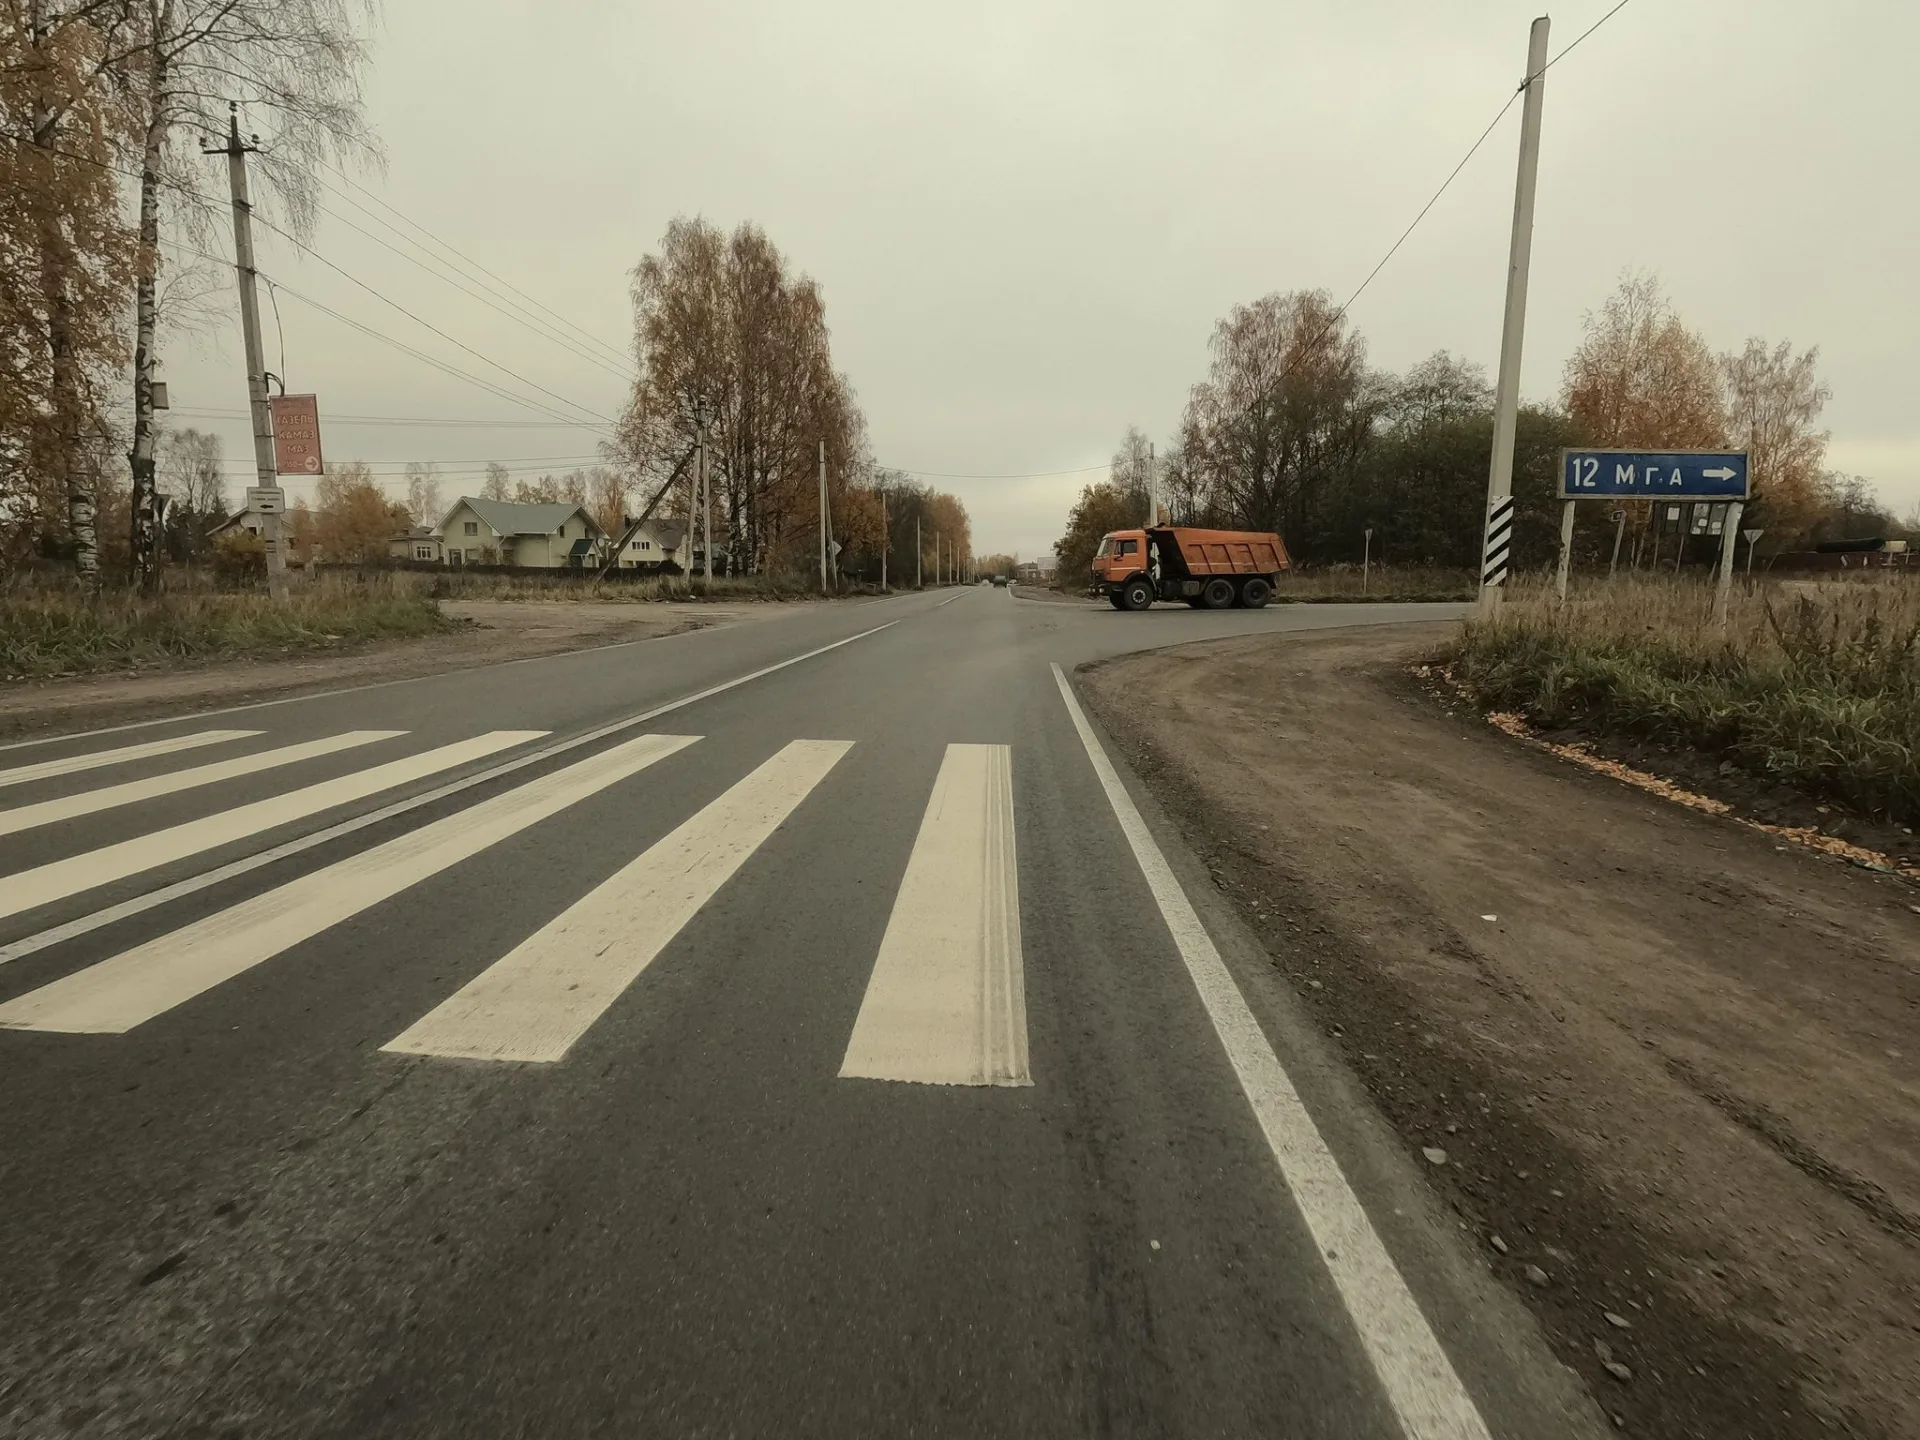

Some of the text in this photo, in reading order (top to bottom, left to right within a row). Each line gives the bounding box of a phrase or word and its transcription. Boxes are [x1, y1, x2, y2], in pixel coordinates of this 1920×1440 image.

[279, 430, 315, 440] КАМАЗ
[287, 445, 309, 454] МАЗ
[1572, 458, 1600, 487] 12
